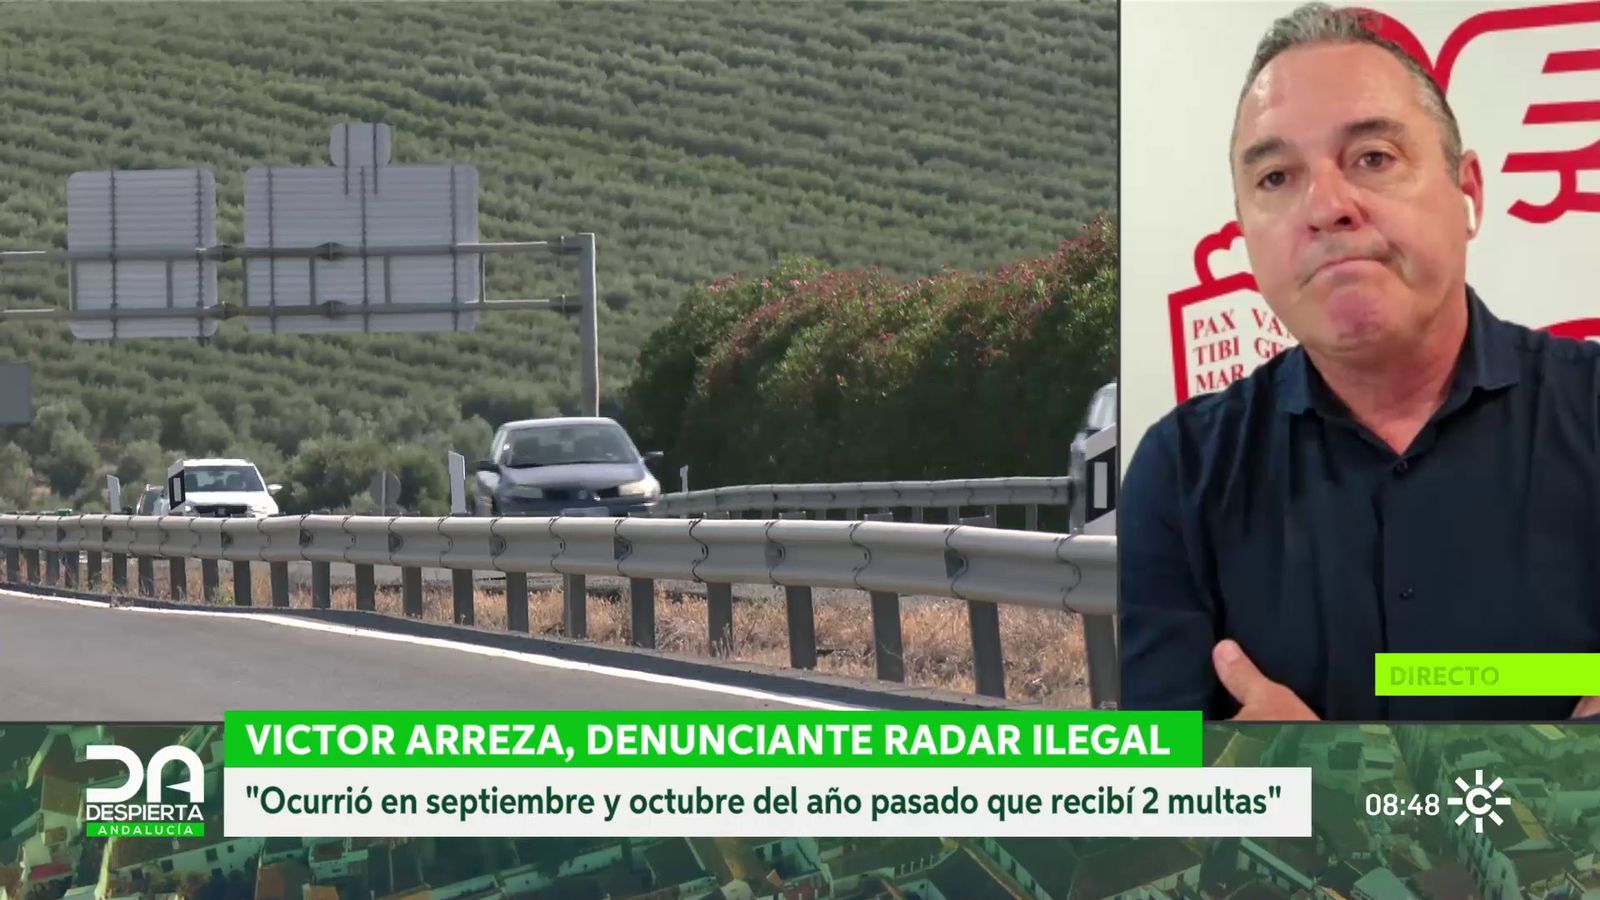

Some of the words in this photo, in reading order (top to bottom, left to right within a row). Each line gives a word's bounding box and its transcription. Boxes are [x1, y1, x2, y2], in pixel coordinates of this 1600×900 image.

[1193, 308, 1236, 340] PAX
[1251, 307, 1293, 339] VA
[1192, 336, 1240, 366] TIBI
[1196, 363, 1244, 394] MAR
